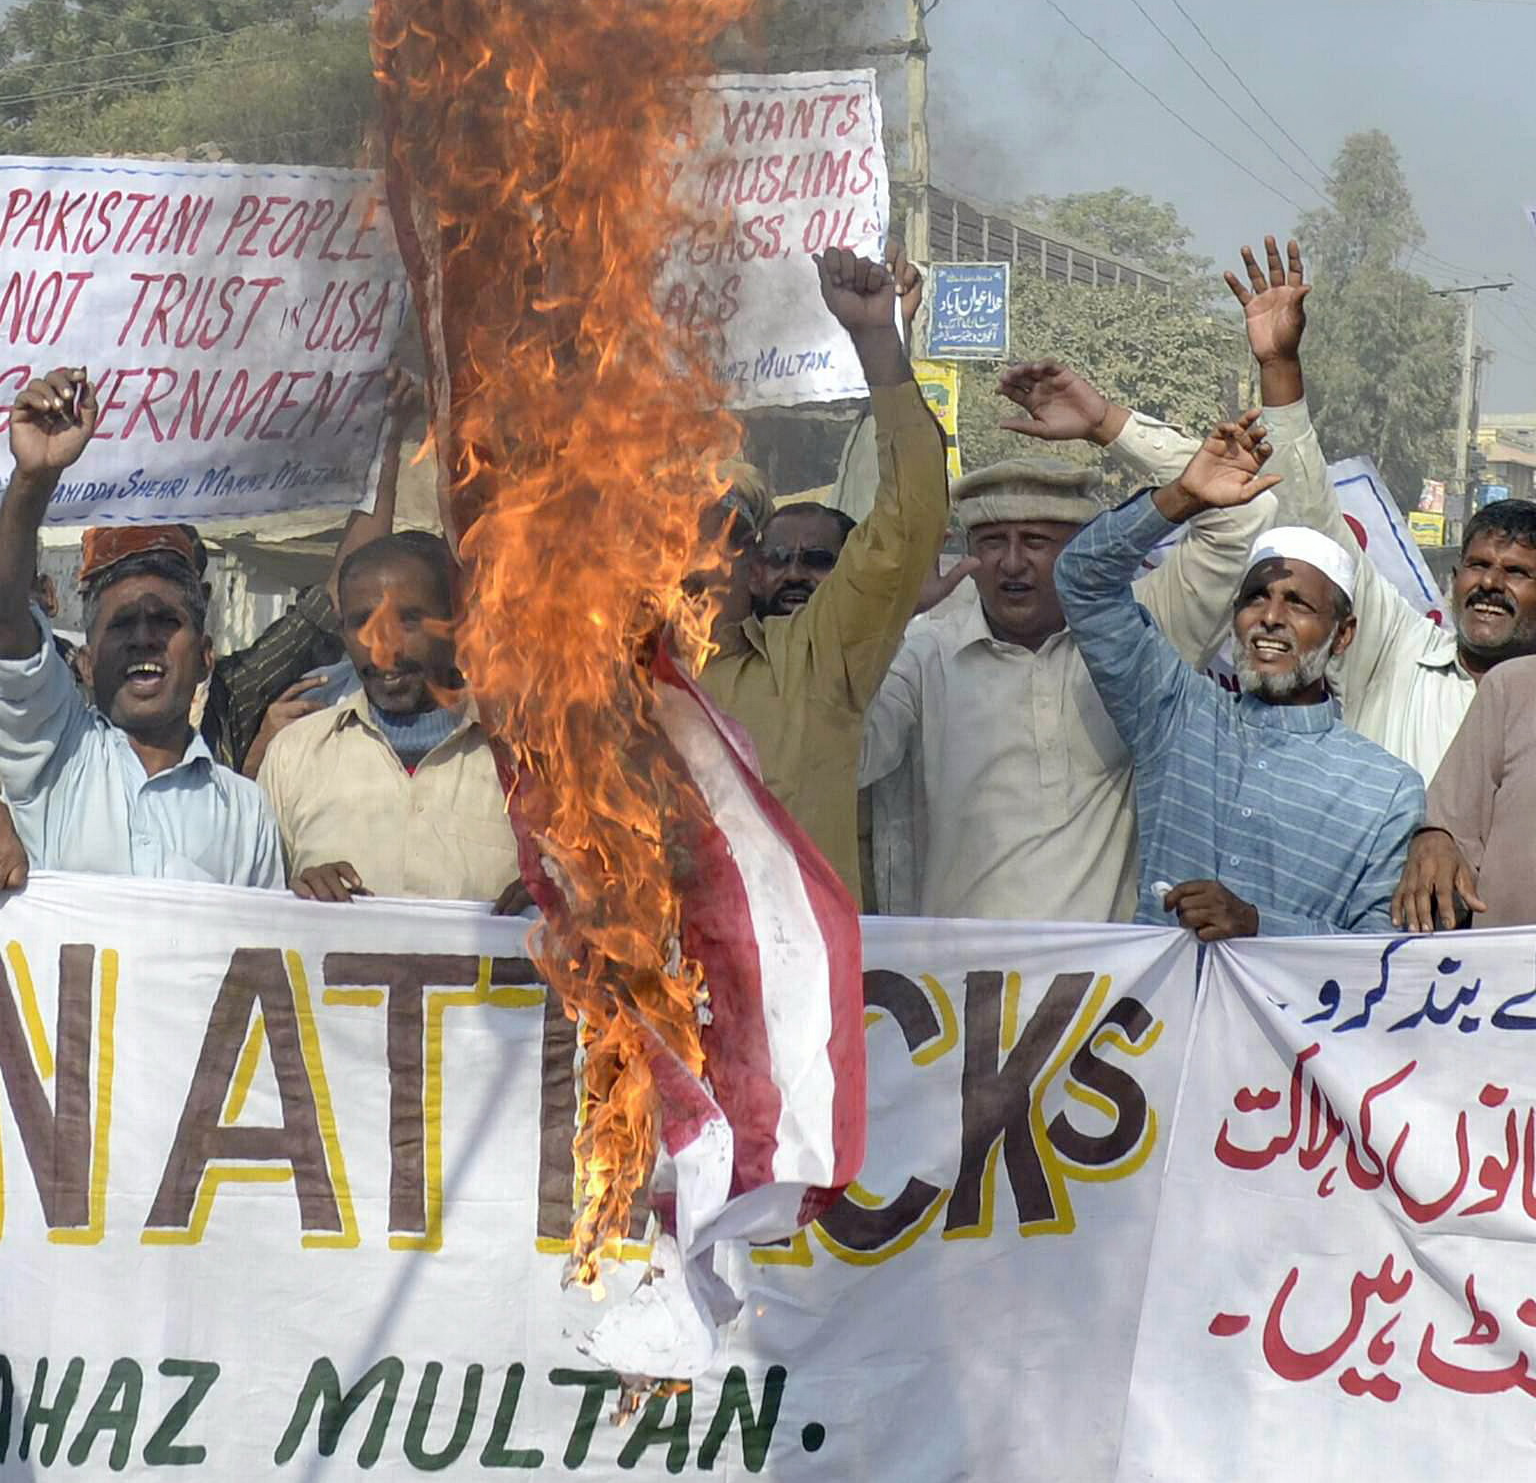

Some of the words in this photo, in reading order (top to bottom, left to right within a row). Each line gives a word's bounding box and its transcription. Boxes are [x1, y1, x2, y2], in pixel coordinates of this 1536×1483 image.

[720, 94, 862, 147] WANTS
[696, 146, 873, 209] MUSLIMS
[216, 194, 385, 260] PEOPLE
[118, 272, 284, 351] TRUST
[279, 297, 309, 339] IN
[118, 468, 190, 500] SHEHRI
[1303, 935, 1433, 1033] کرو
[1387, 957, 1481, 1034] بند
[141, 945, 1163, 1267] ATTCKS
[274, 1354, 826, 1474] MULTAN.
